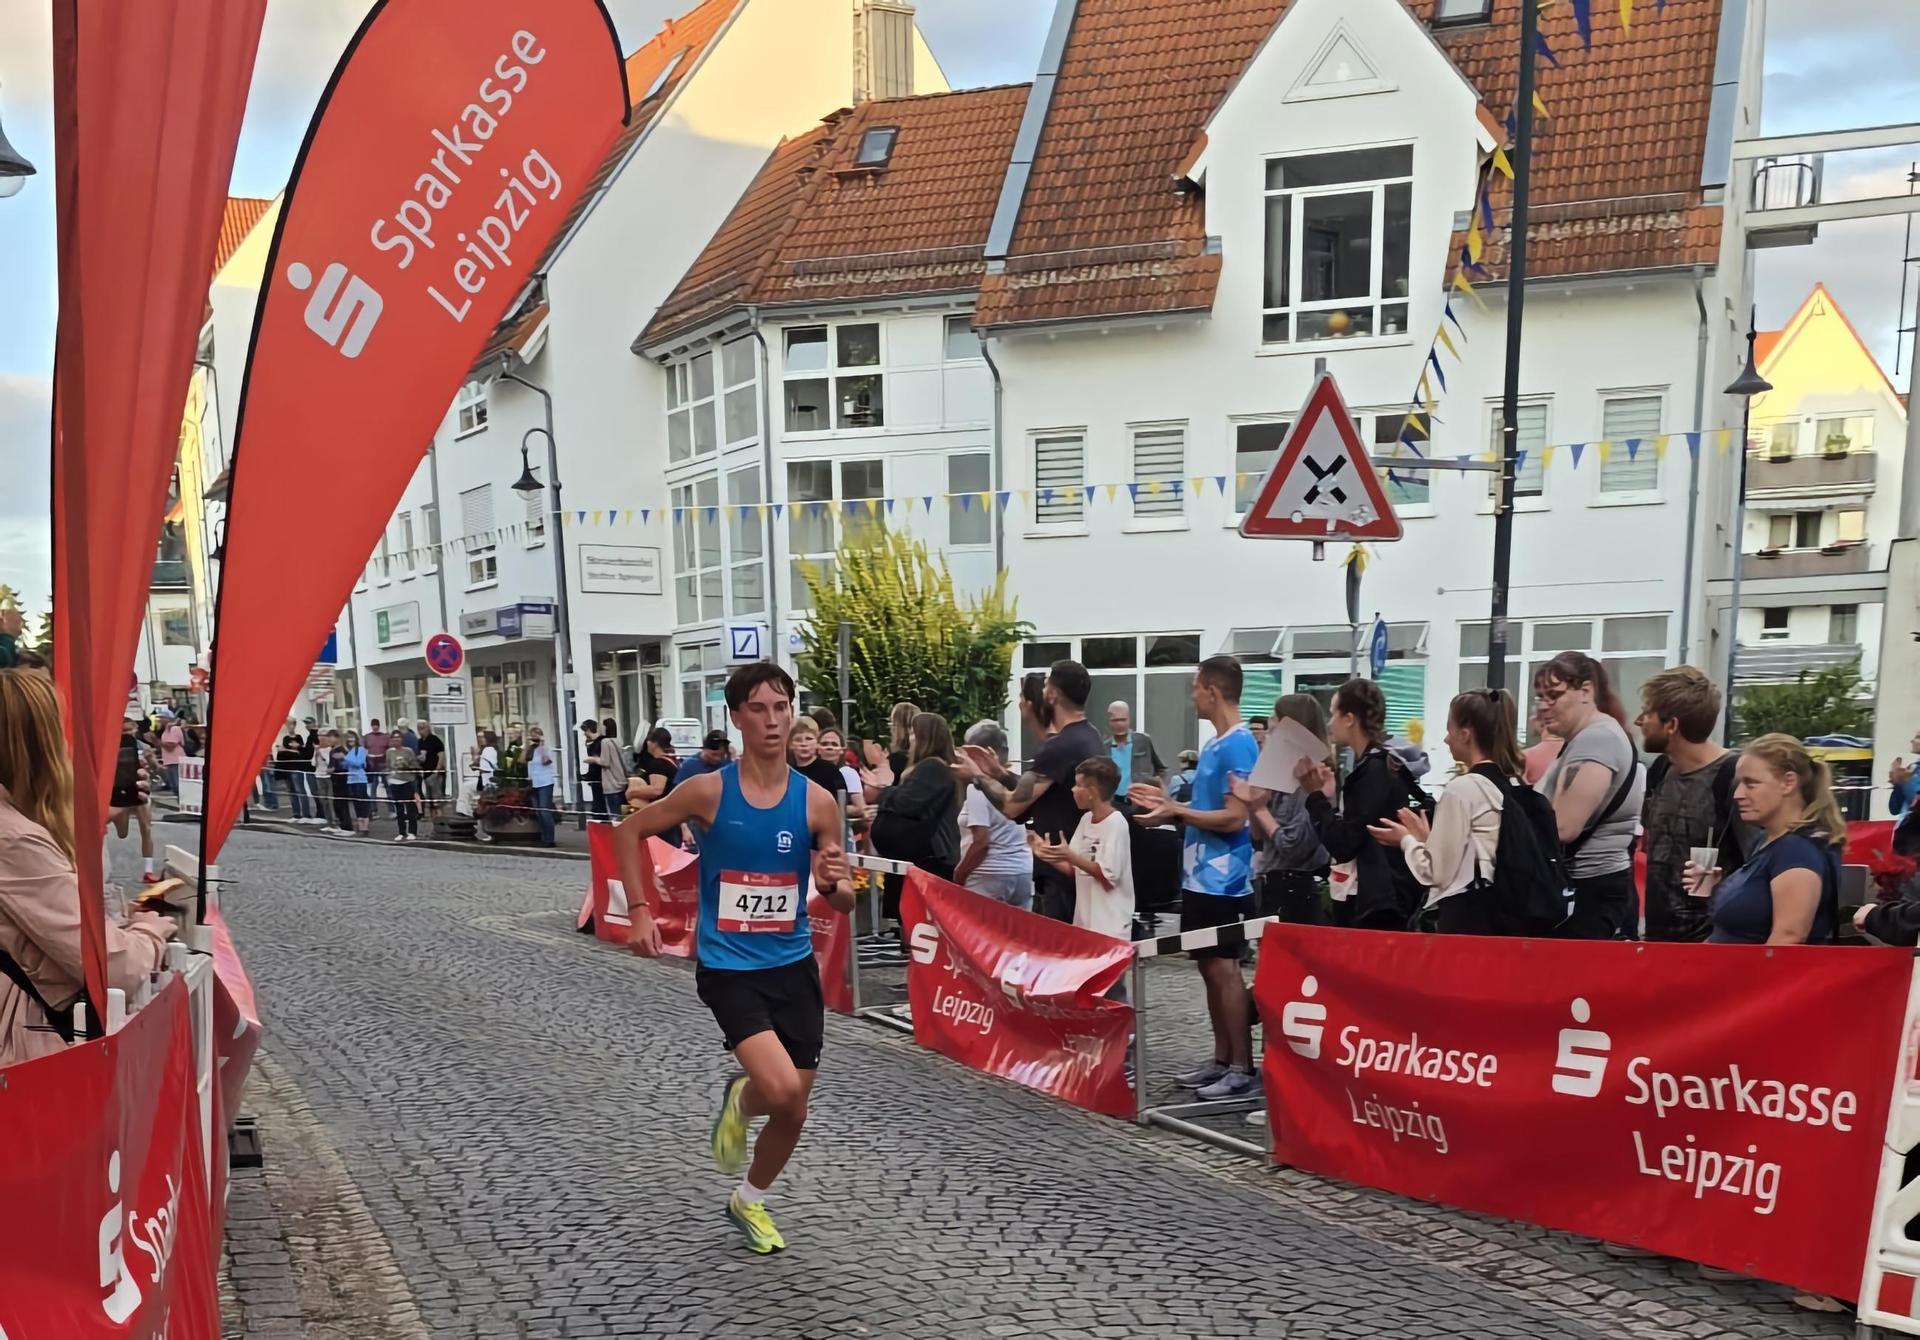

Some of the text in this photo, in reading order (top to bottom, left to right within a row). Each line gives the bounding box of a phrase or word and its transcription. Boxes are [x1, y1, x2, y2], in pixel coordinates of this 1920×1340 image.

[370, 29, 546, 270] Sparkasse
[427, 148, 562, 322] Leipzig
[735, 894, 787, 912] 4712
[931, 985, 995, 1035] Leipzig
[1335, 1025, 1498, 1088] Sparkasse
[1346, 1088, 1448, 1154] Leipzig
[1624, 1056, 1858, 1133] Sparkasse
[1632, 1130, 1782, 1215] Leipzig
